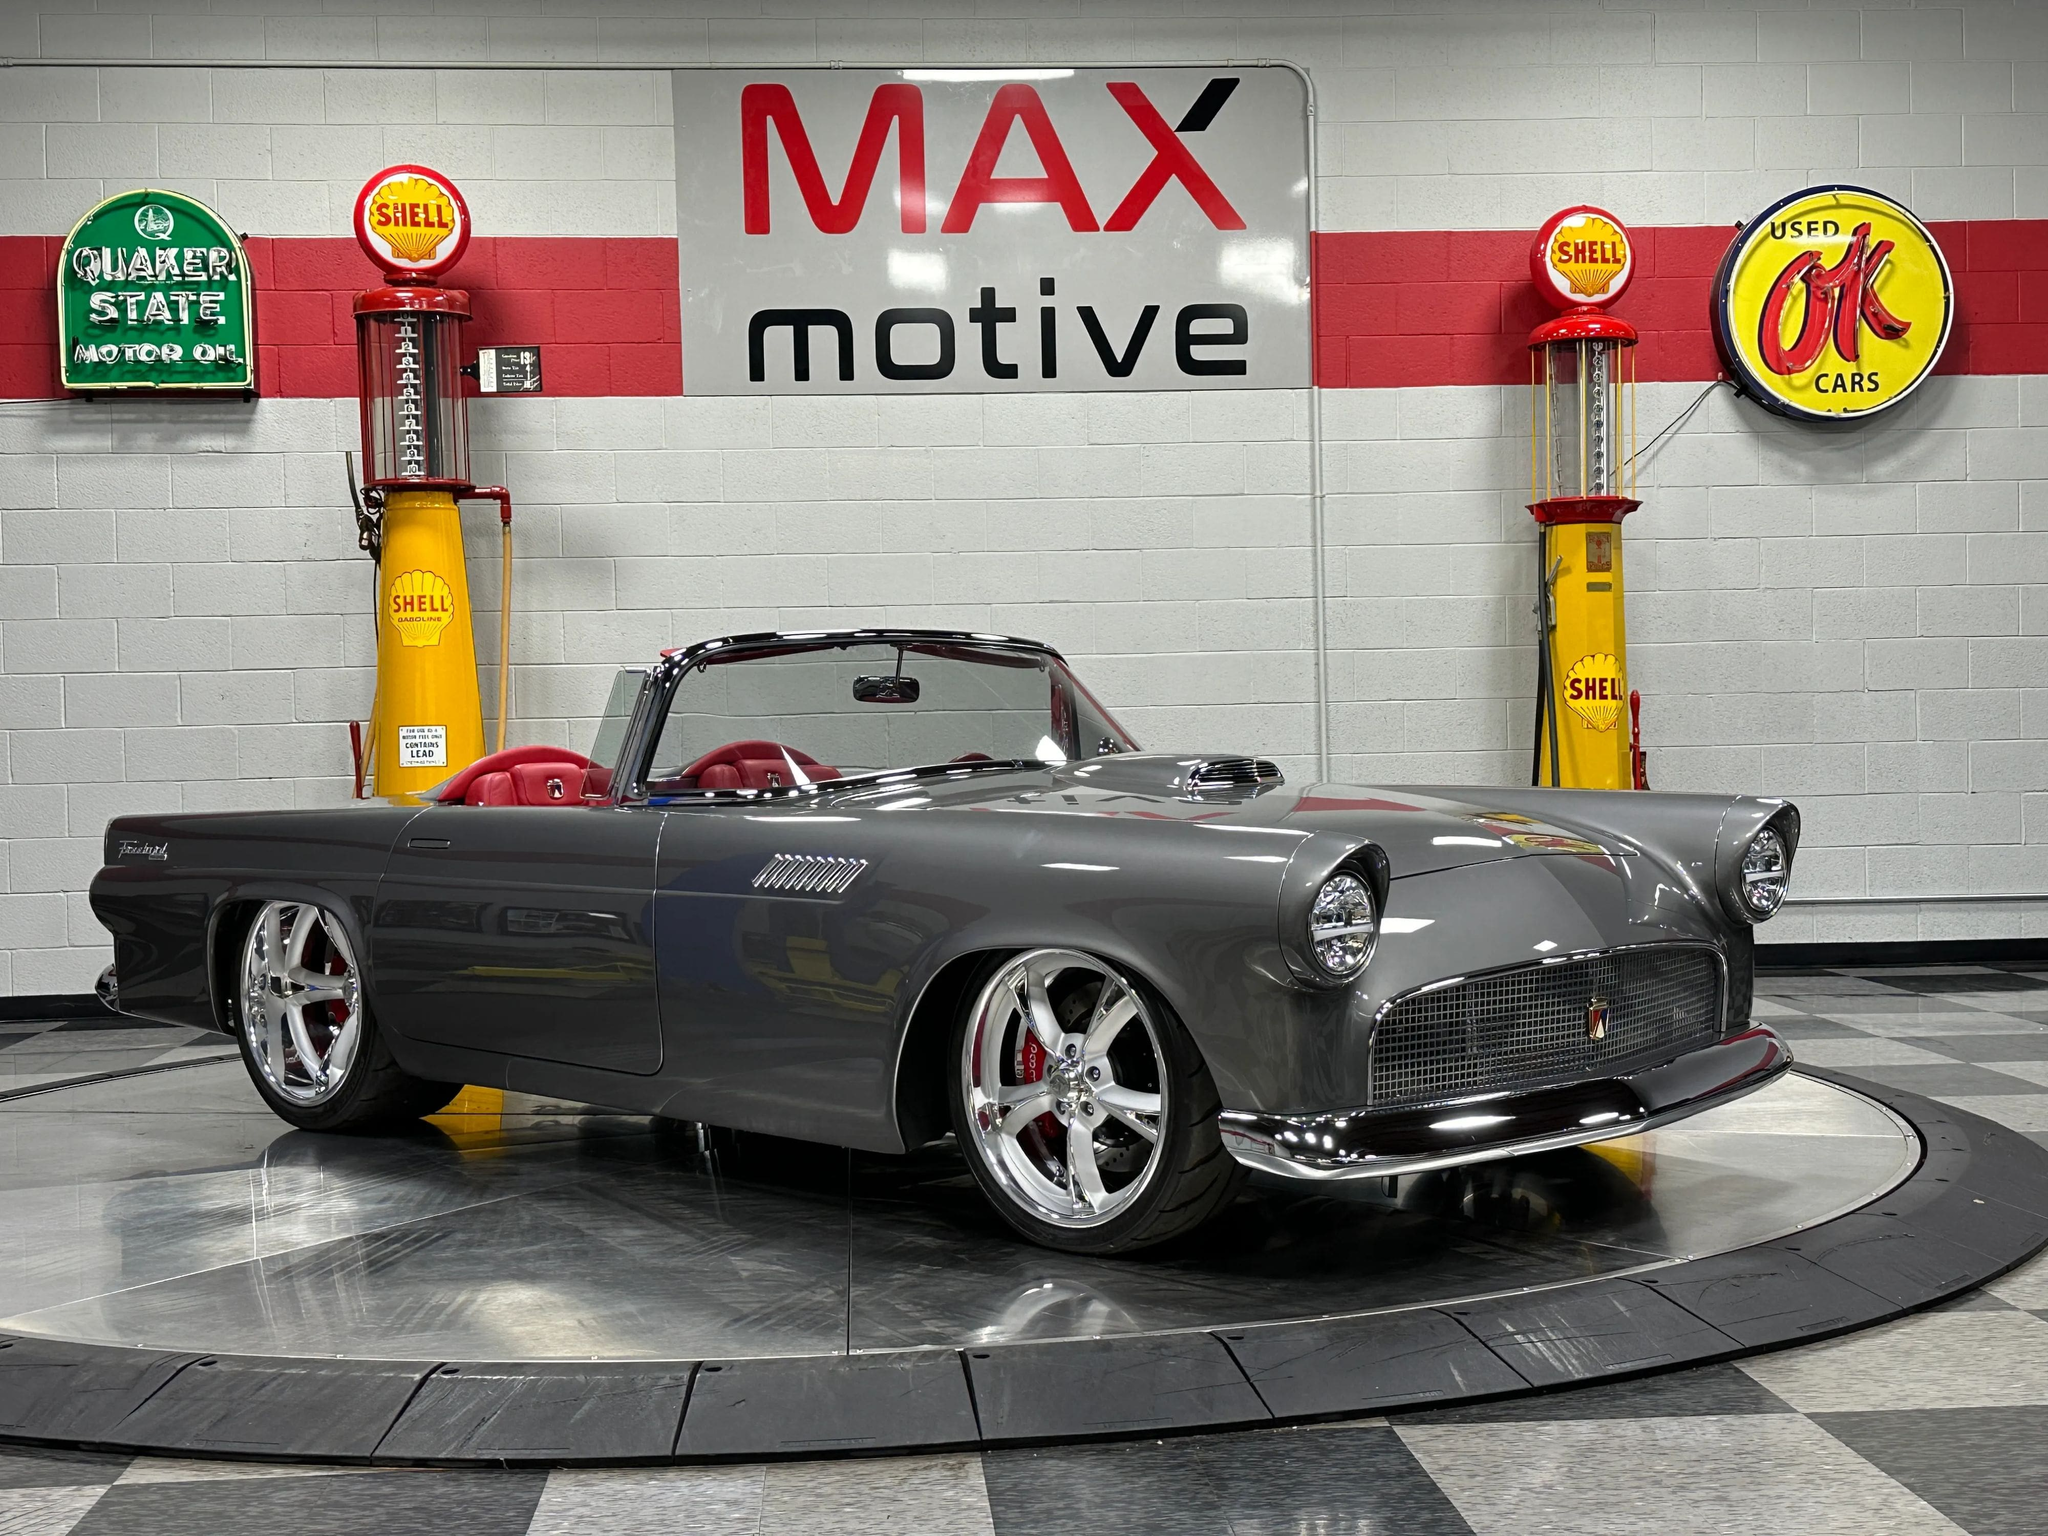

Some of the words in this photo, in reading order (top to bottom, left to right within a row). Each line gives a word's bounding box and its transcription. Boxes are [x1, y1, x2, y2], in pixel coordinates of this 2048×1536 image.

[741, 78, 1247, 235] MAX
[376, 202, 450, 229] SHELL
[1770, 220, 1840, 240] USED
[1557, 240, 1622, 265] SHELL
[73, 246, 237, 286] QUAKER
[89, 291, 226, 326] STATE
[748, 277, 1249, 382] motive
[74, 343, 183, 364] MOTOR
[193, 344, 243, 366] OIL
[403, 342, 411, 351] 2
[404, 358, 411, 366] 3
[1815, 372, 1880, 393] CARS
[405, 389, 412, 397] 5
[406, 420, 413, 428] 7
[407, 435, 415, 443] 8
[408, 450, 415, 458] 9
[393, 594, 449, 613] SHELL
[1569, 677, 1623, 701] SHELL
[405, 741, 439, 749] CONTAINS
[410, 750, 434, 758] LEAD
